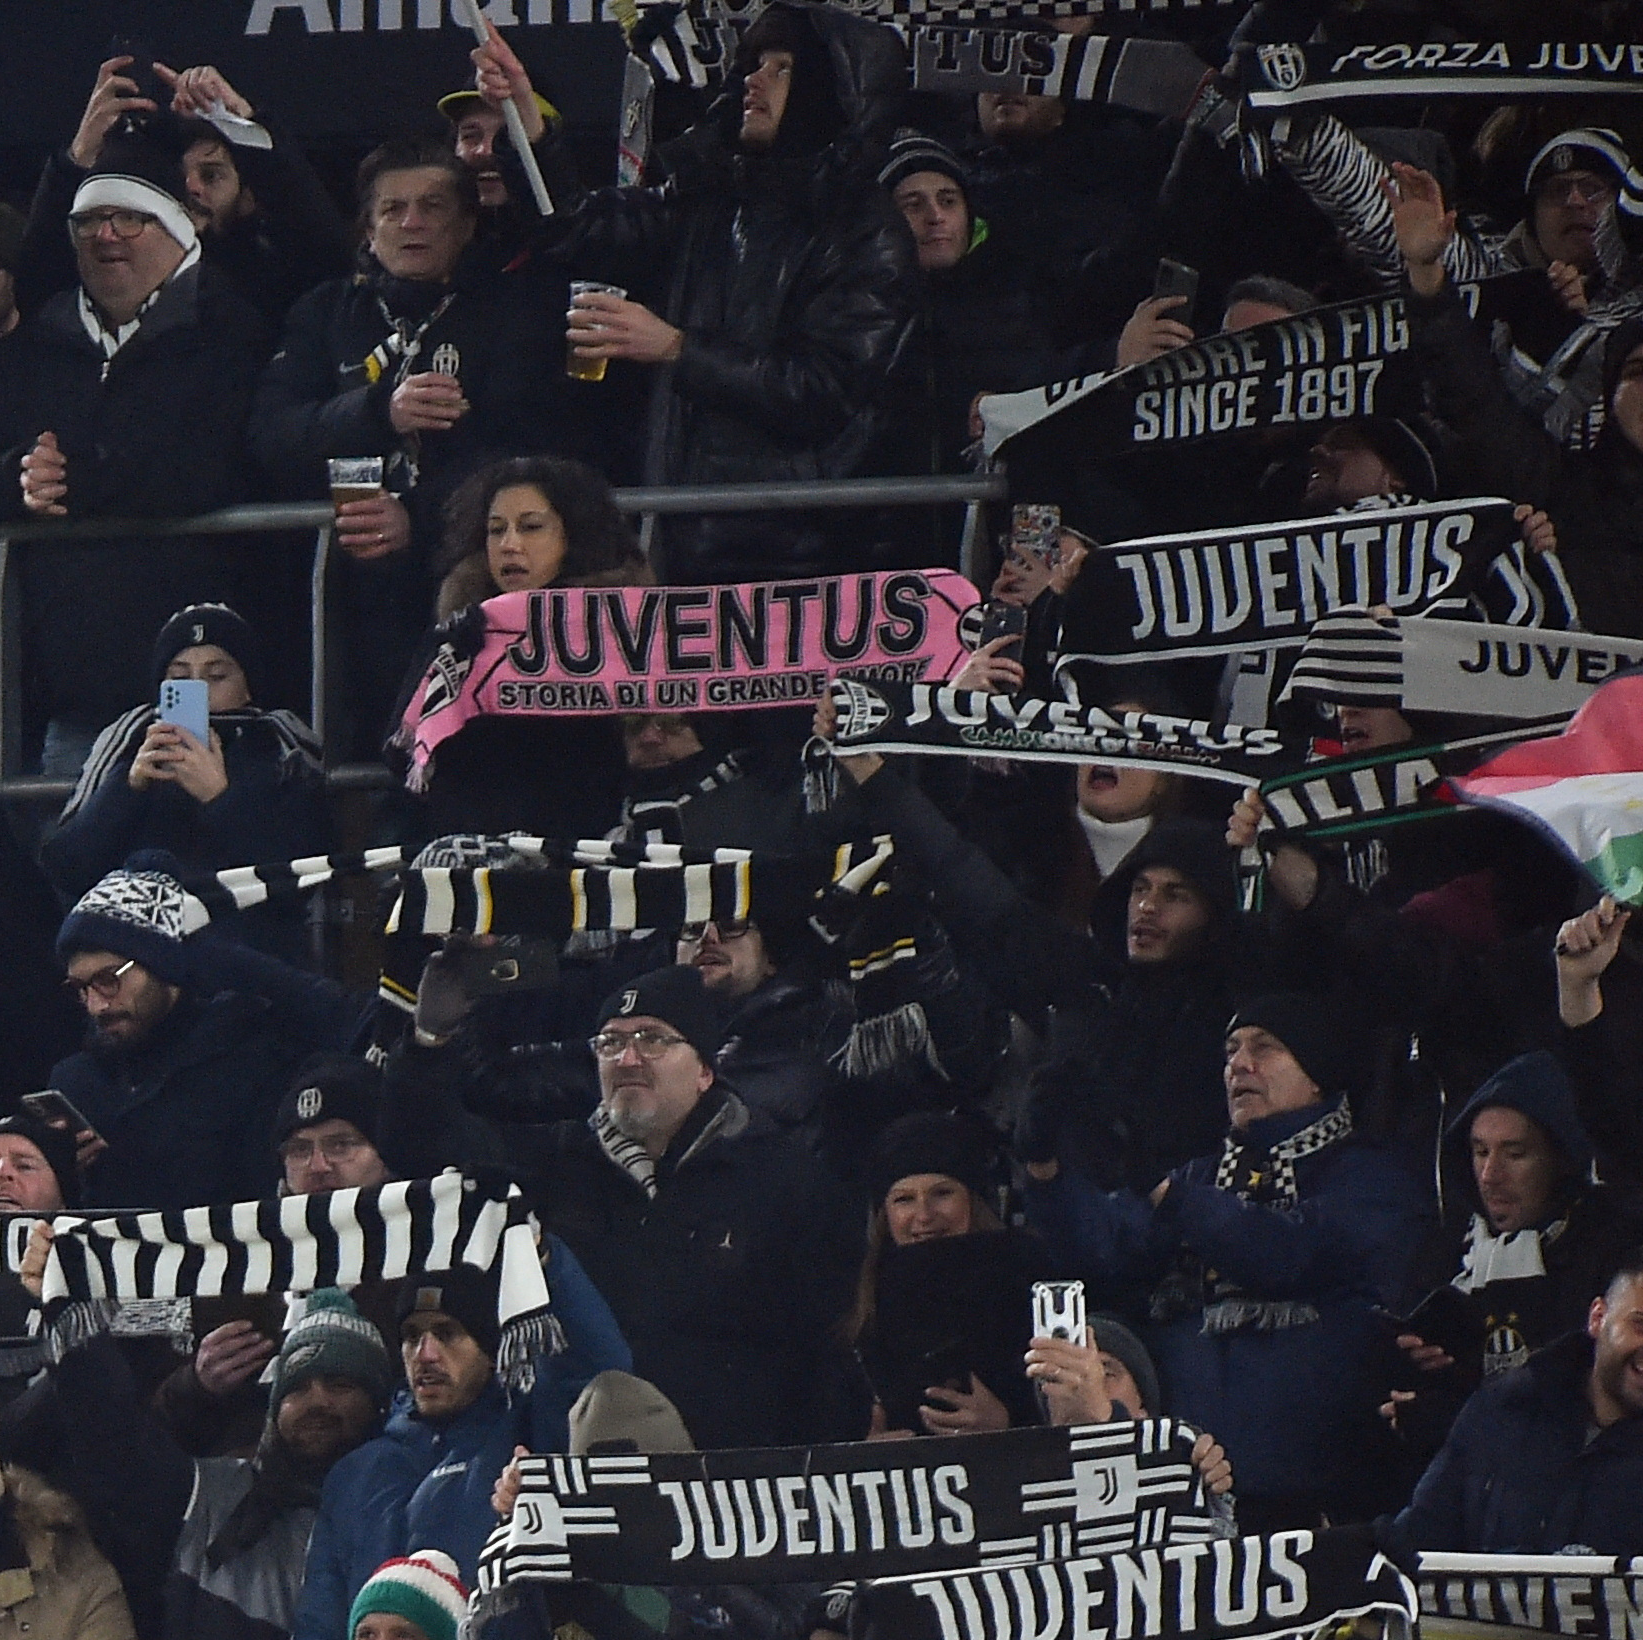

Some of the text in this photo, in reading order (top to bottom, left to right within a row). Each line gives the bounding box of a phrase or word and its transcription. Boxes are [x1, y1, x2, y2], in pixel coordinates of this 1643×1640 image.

[1331, 41, 1512, 75] FORZA
[1282, 298, 1411, 367] IN FIG
[1132, 357, 1385, 443] SINCE 1897
[1115, 514, 1475, 641] JUVENTUS
[505, 570, 933, 677] JUVENTUS
[499, 680, 610, 710] STORIA
[616, 680, 649, 708] DI
[655, 678, 702, 707] UN
[707, 672, 830, 702] GRANDE
[905, 684, 1284, 755] JUVENTUS
[661, 1463, 976, 1564] JUVENTUS
